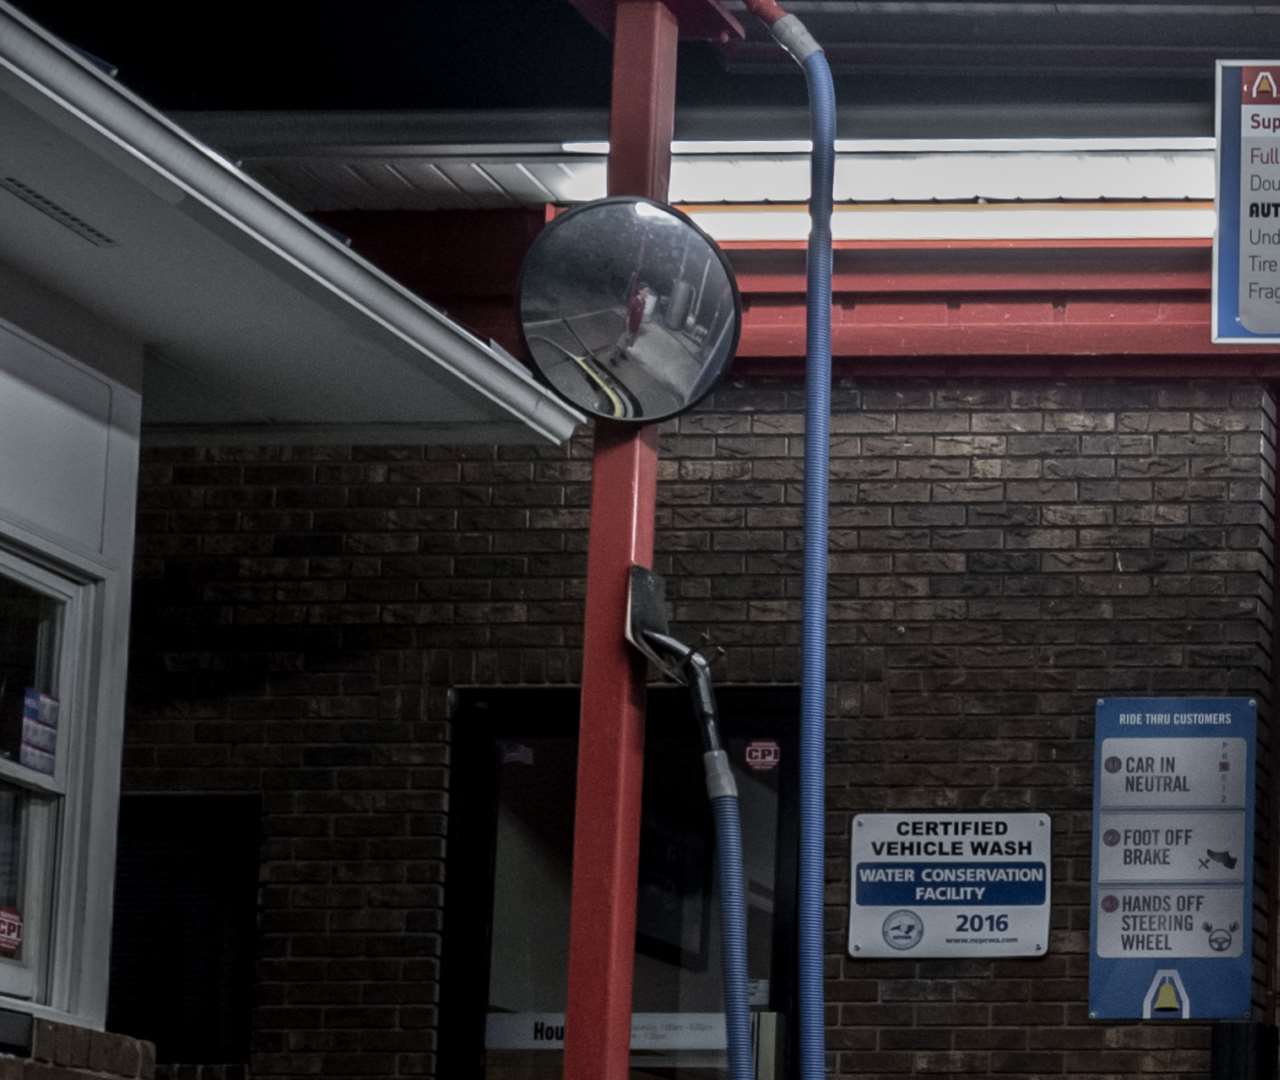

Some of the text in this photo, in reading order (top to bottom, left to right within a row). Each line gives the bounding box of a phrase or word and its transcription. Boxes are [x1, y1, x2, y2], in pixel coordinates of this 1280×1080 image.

[1250, 148, 1279, 164] Full
[1250, 256, 1278, 273] Tire
[1120, 712, 1232, 726] RIDE THRU CUSTOMERS
[1126, 756, 1155, 774] CAR
[1160, 756, 1176, 774] IN
[1124, 775, 1191, 793] NEUTRAL
[896, 821, 1008, 836] CERTIFIED
[1124, 829, 1160, 846] FOOT
[1164, 829, 1193, 846] OFF
[871, 840, 1032, 856] VEHICLE WASH
[1123, 850, 1170, 865] BRAKE
[859, 868, 1044, 882] WATER CONSERVATION
[915, 887, 986, 900] FACILITY
[1122, 896, 1171, 912] HANDS
[1176, 896, 1205, 912] OFF
[955, 914, 1009, 932] 2016
[1121, 915, 1194, 932] STEERING
[1120, 934, 1172, 950] WHEEL
